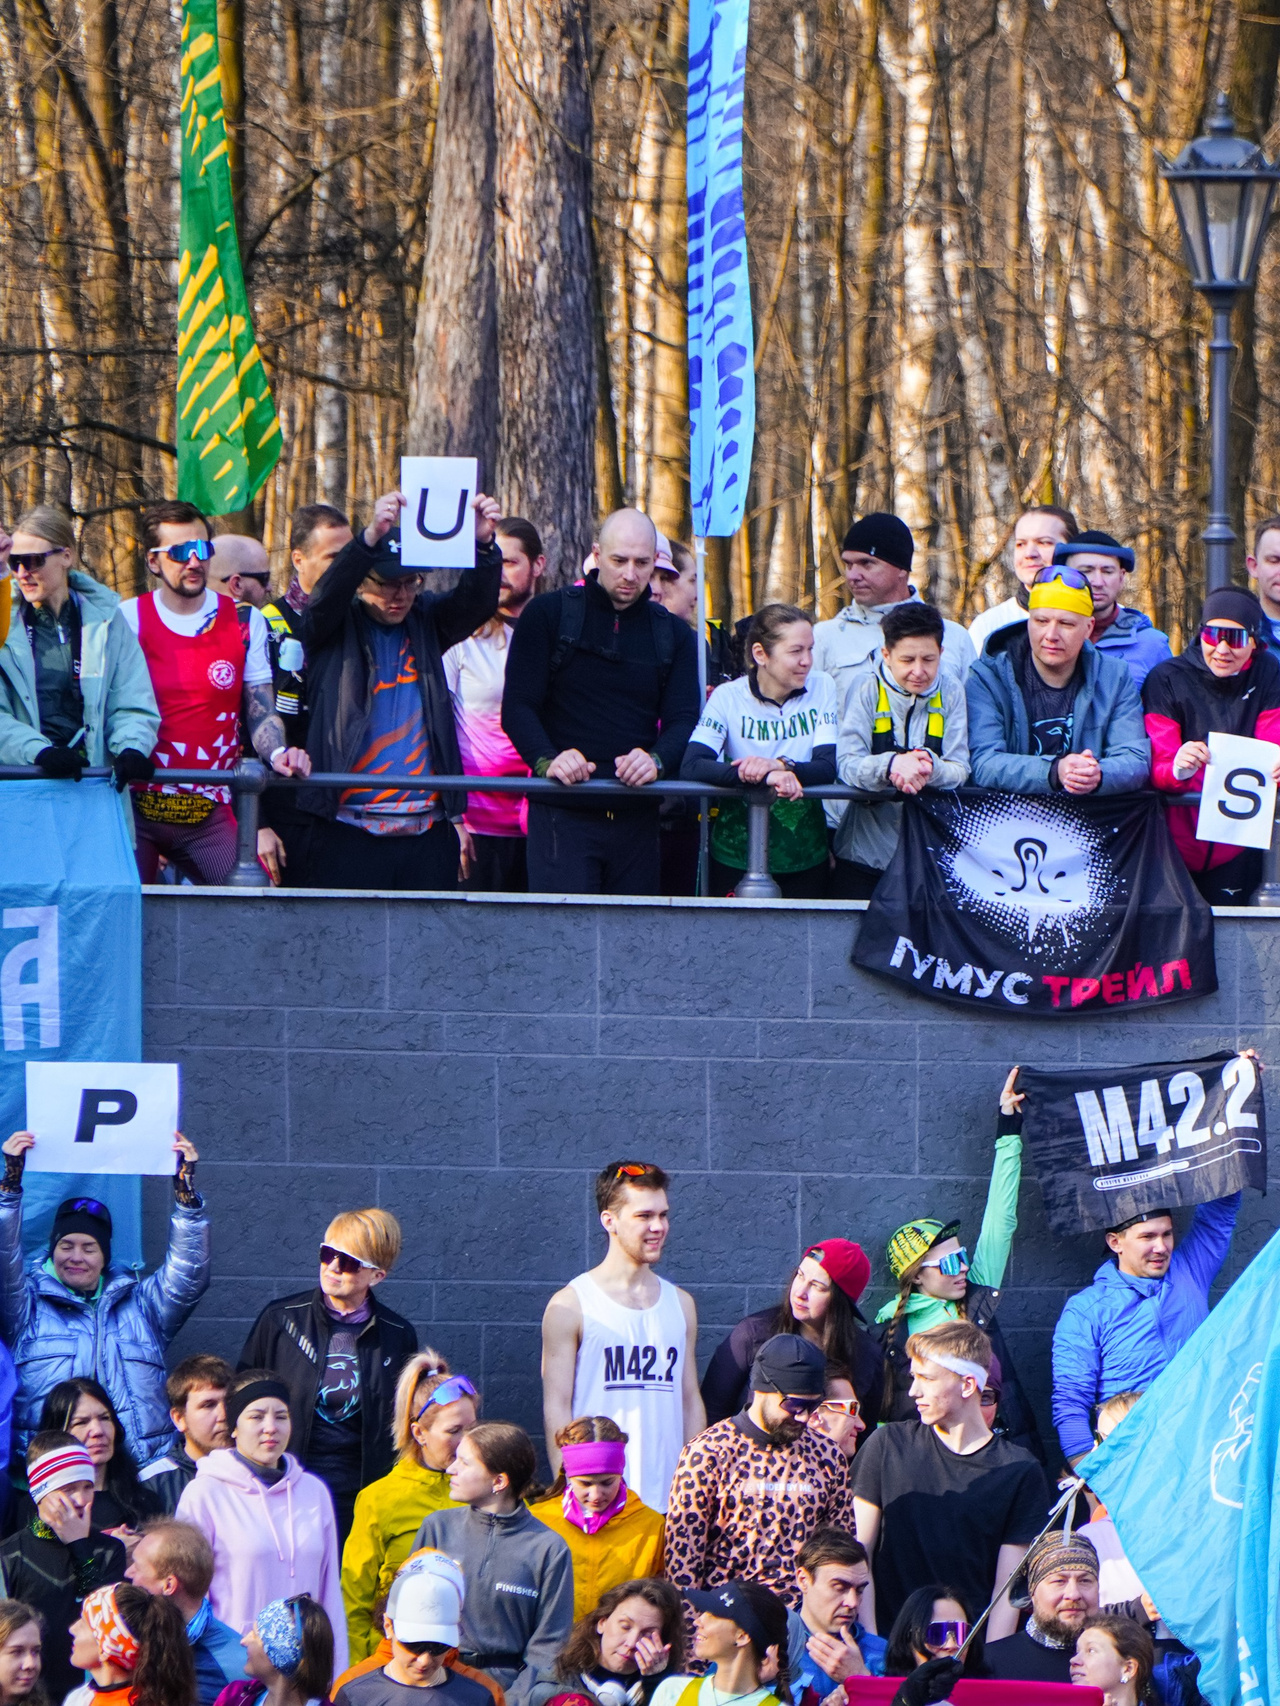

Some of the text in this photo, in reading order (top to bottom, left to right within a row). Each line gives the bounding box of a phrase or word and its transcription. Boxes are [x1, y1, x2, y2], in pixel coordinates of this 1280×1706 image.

[416, 488, 469, 541] U
[1218, 767, 1266, 821] S
[1042, 958, 1193, 1008] ТРЕЙЛ
[74, 1088, 138, 1143] P
[1074, 1056, 1259, 1167] M42.2
[604, 1345, 678, 1382] M42.2
[495, 1582, 539, 1598] FINISHER
